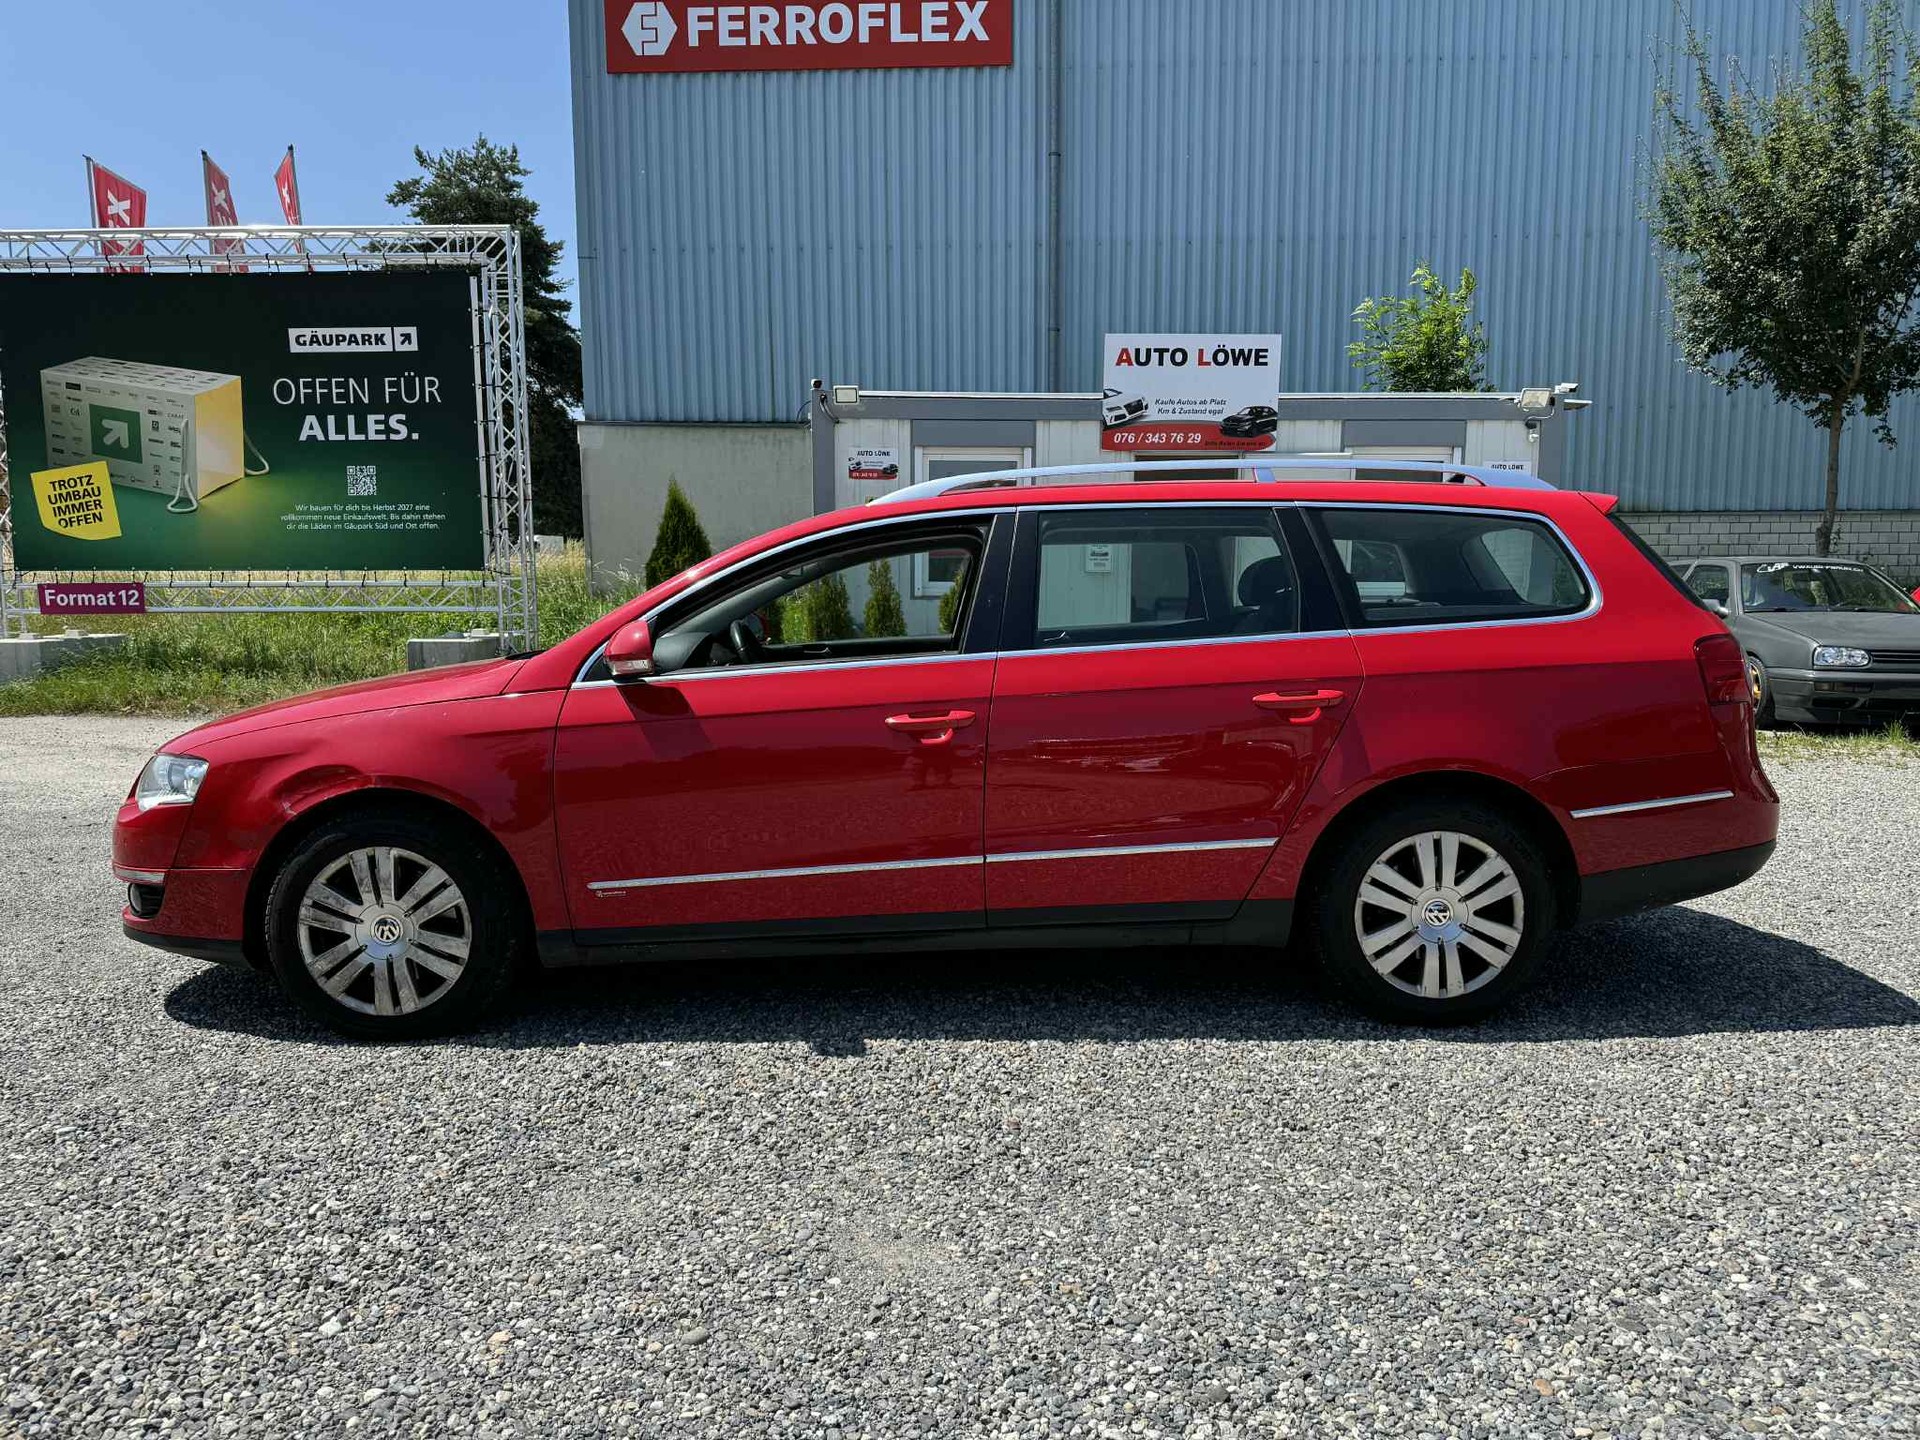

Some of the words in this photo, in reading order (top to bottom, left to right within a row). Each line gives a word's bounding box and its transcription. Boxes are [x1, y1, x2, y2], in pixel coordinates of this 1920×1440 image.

[687, 1, 990, 47] FERROFLEX
[295, 330, 386, 346] GÄUPARK
[1115, 347, 1188, 367] AUTO
[1197, 345, 1269, 367] LÖWE
[273, 378, 369, 405] OFFEN
[384, 371, 442, 404] FÜR
[1208, 407, 1224, 416] egal
[299, 413, 420, 441] ALLES.
[1113, 432, 1135, 443] 076
[1137, 432, 1144, 443] /
[1145, 432, 1166, 443] 343
[1170, 432, 1184, 443] 76
[1187, 432, 1202, 443] 29
[49, 474, 94, 491] TROTZ
[48, 486, 101, 505] UMBAU
[52, 499, 103, 517] IMMER
[334, 503, 343, 511] für
[345, 503, 360, 511] dich
[361, 503, 371, 511] bis
[373, 503, 396, 511] Herbst
[397, 503, 413, 511] 2027
[415, 503, 430, 511] eine
[58, 512, 103, 528] OFFEN
[344, 522, 373, 531] Gäupark
[375, 522, 388, 530] Süd
[390, 522, 404, 530] und
[405, 522, 418, 530] Ost
[44, 589, 116, 606] Format
[118, 589, 140, 606] 12
